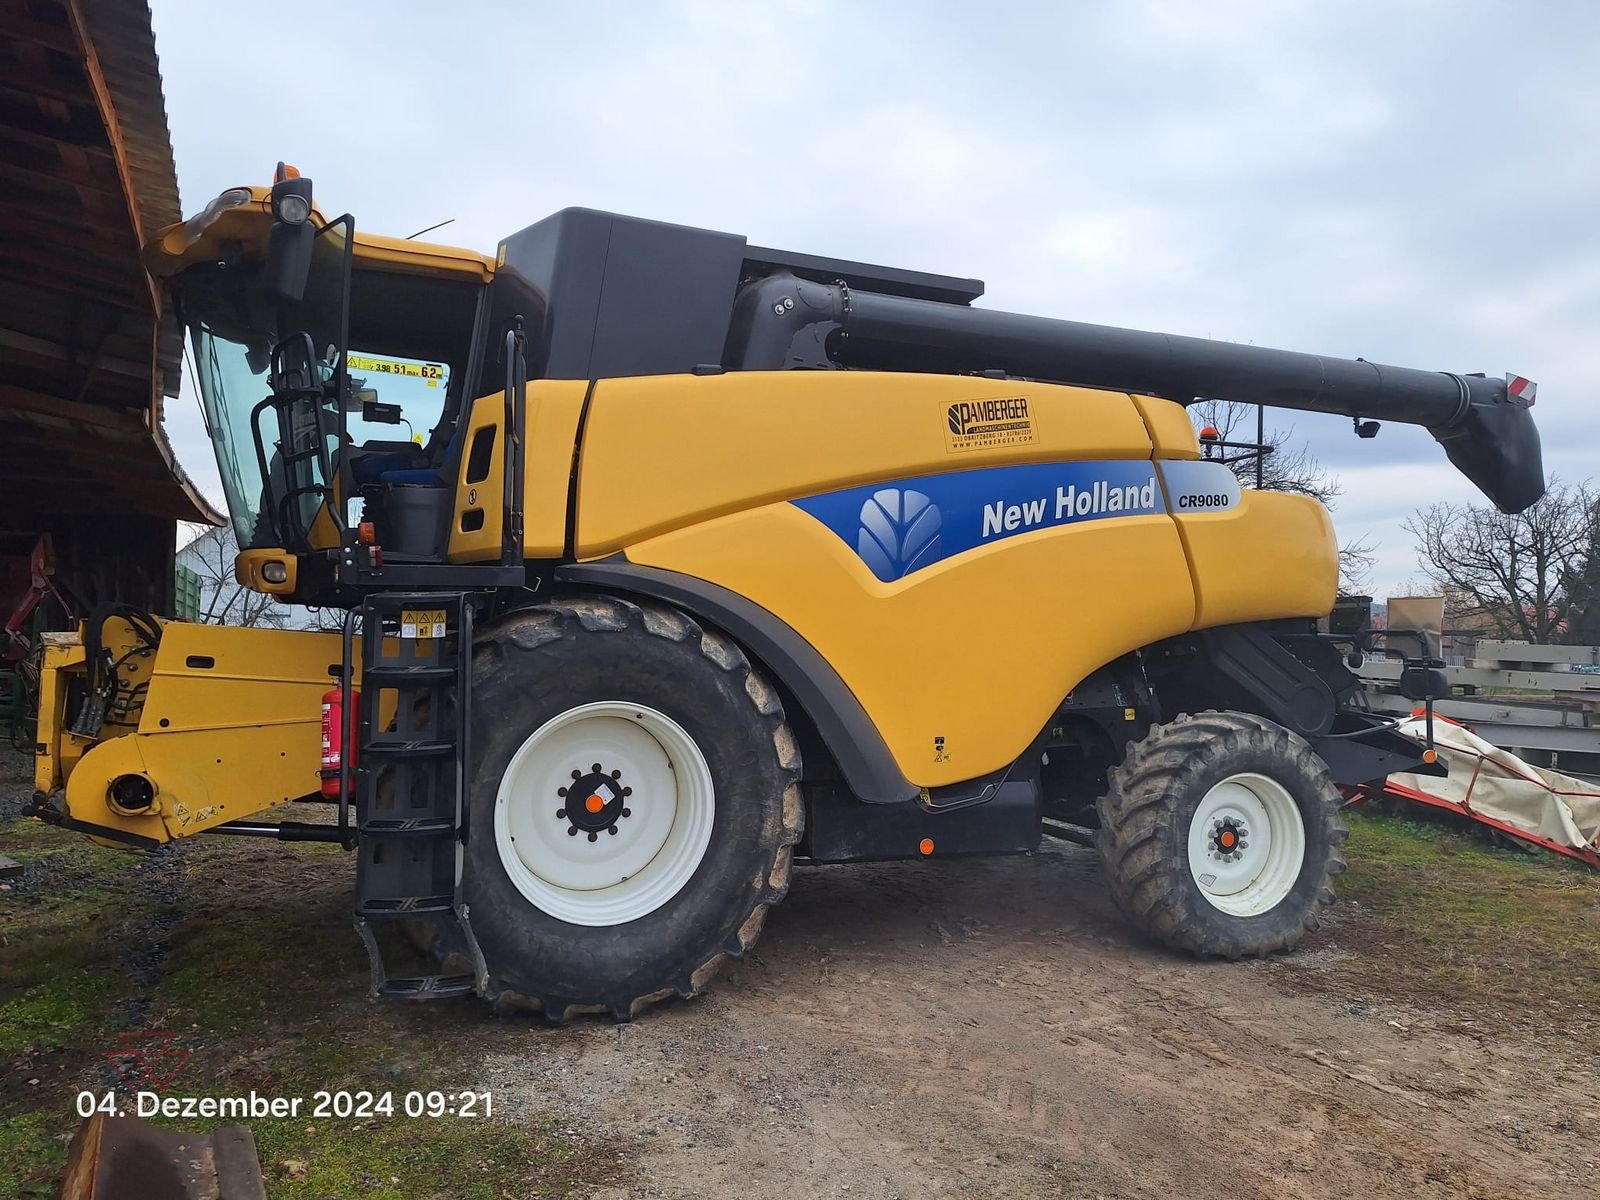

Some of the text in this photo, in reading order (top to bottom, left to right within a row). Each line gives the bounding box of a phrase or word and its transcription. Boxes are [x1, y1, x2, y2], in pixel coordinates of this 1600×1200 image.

[960, 398, 1029, 435] PAMBERGER
[982, 478, 1155, 538] New Holland
[1178, 494, 1229, 508] CR9080
